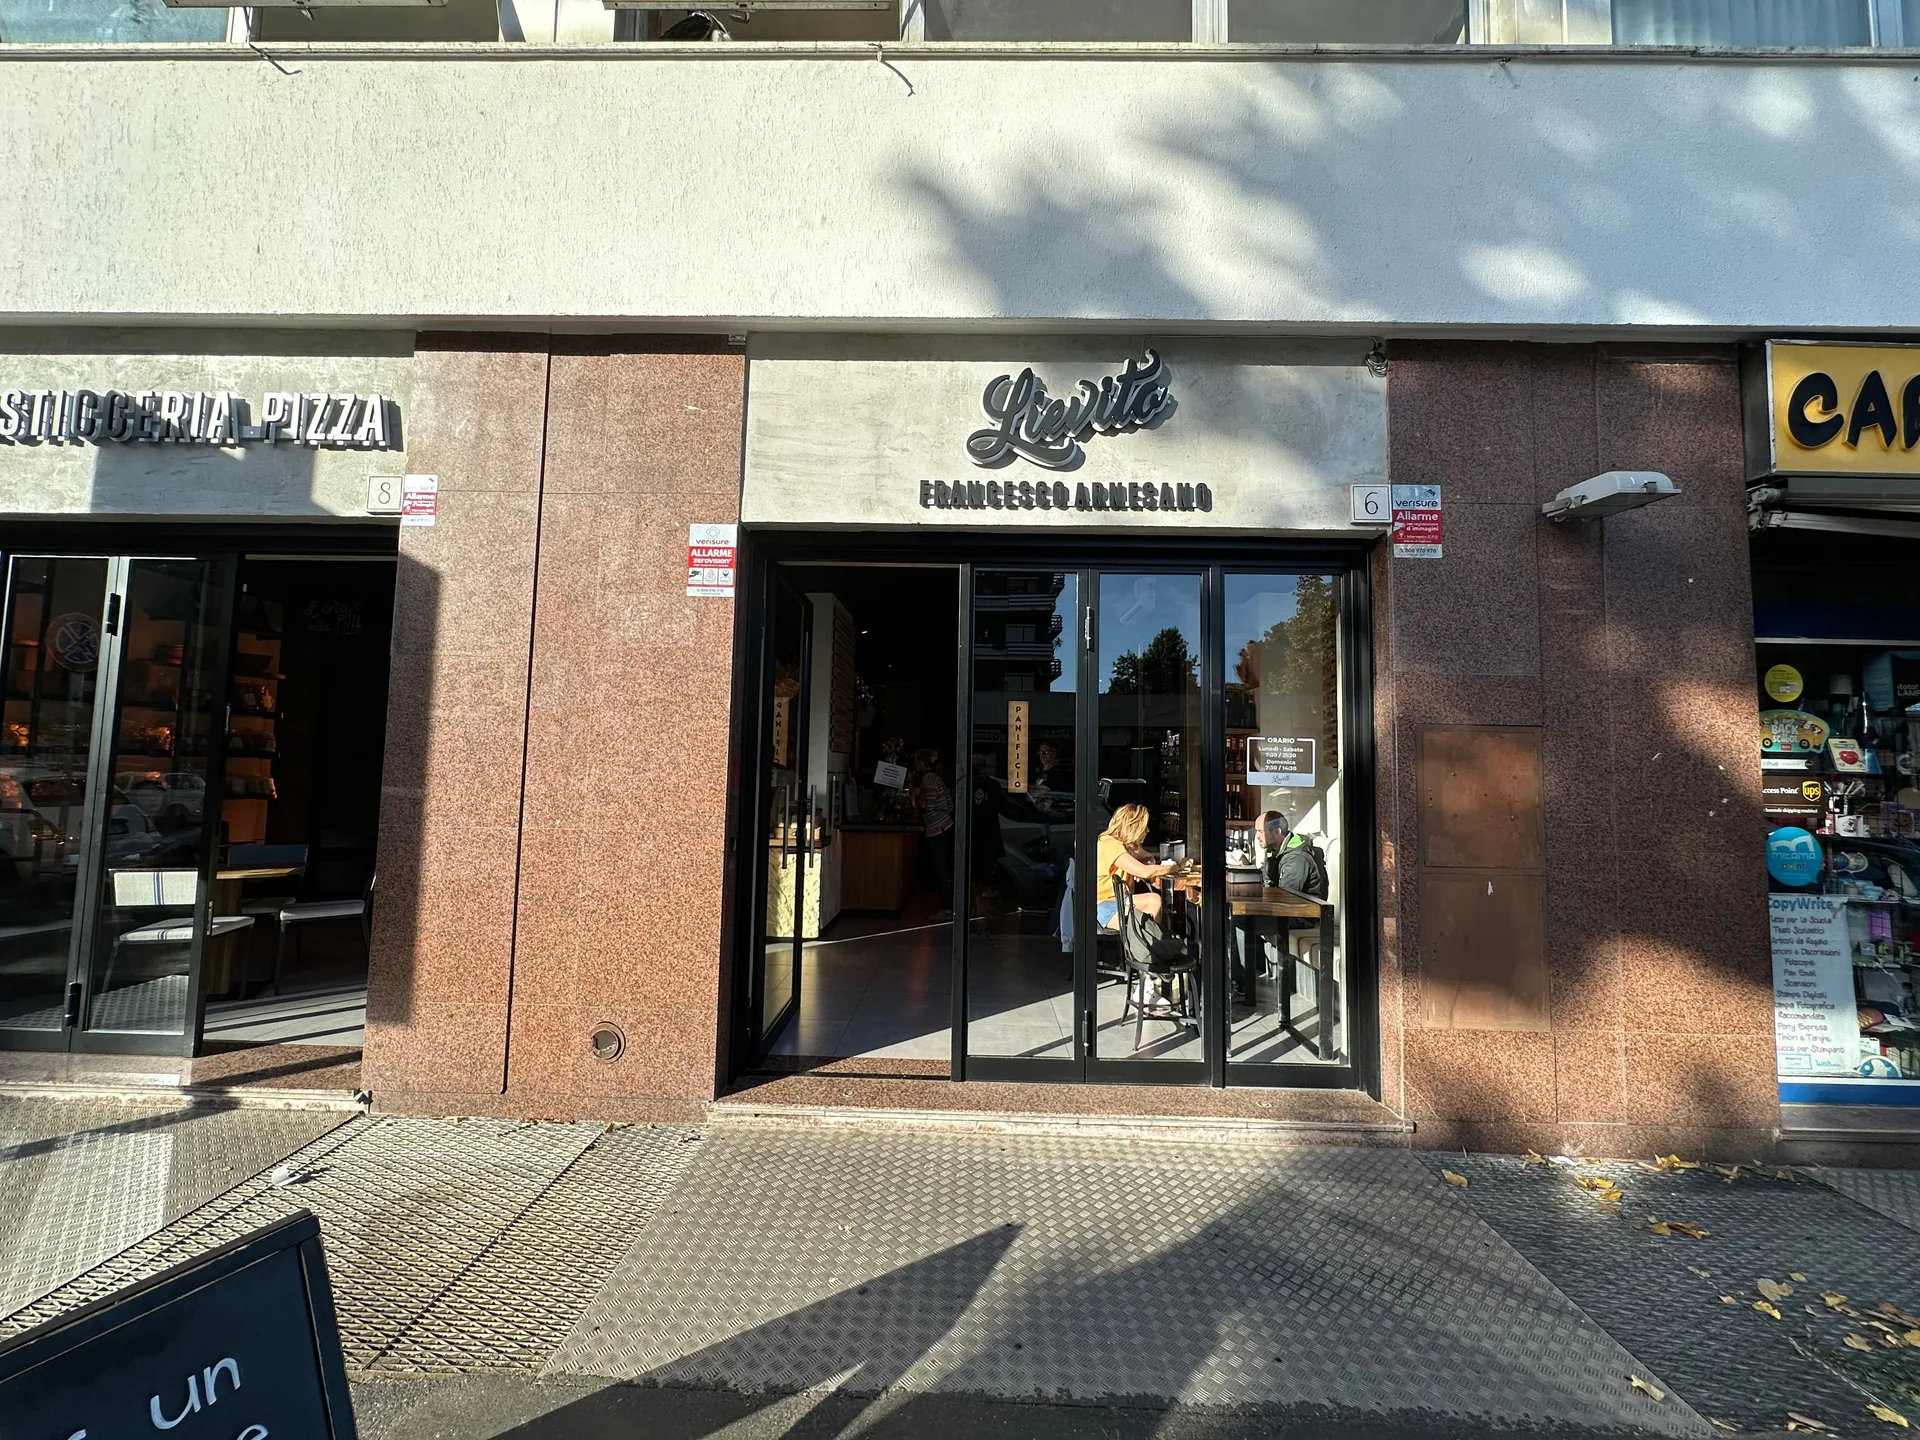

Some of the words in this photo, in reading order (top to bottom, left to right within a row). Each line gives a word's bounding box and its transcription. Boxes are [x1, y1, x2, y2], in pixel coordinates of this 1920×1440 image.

[966, 349, 1170, 467] Lievito
[260, 391, 392, 447] PIZZA
[378, 482, 391, 504] 8
[405, 492, 436, 500] Allarme
[919, 479, 1069, 511] FRANCESCO
[1074, 481, 1213, 512] ARNESANO
[1364, 491, 1379, 515] 6
[1396, 511, 1438, 521] Allarme
[691, 549, 733, 557] ALLARME
[1771, 723, 1799, 735] BACK
[1014, 705, 1023, 789] PANIFICIO
[1804, 787, 1820, 798] ups
[1787, 917, 1799, 925] per
[1809, 916, 1832, 924] Scuola
[1797, 1001, 1836, 1010] Fotografica
[1777, 1022, 1797, 1032] Pony
[1798, 1022, 1829, 1032] Express
[1797, 1045, 1809, 1054] per
[150, 1356, 241, 1430] un
